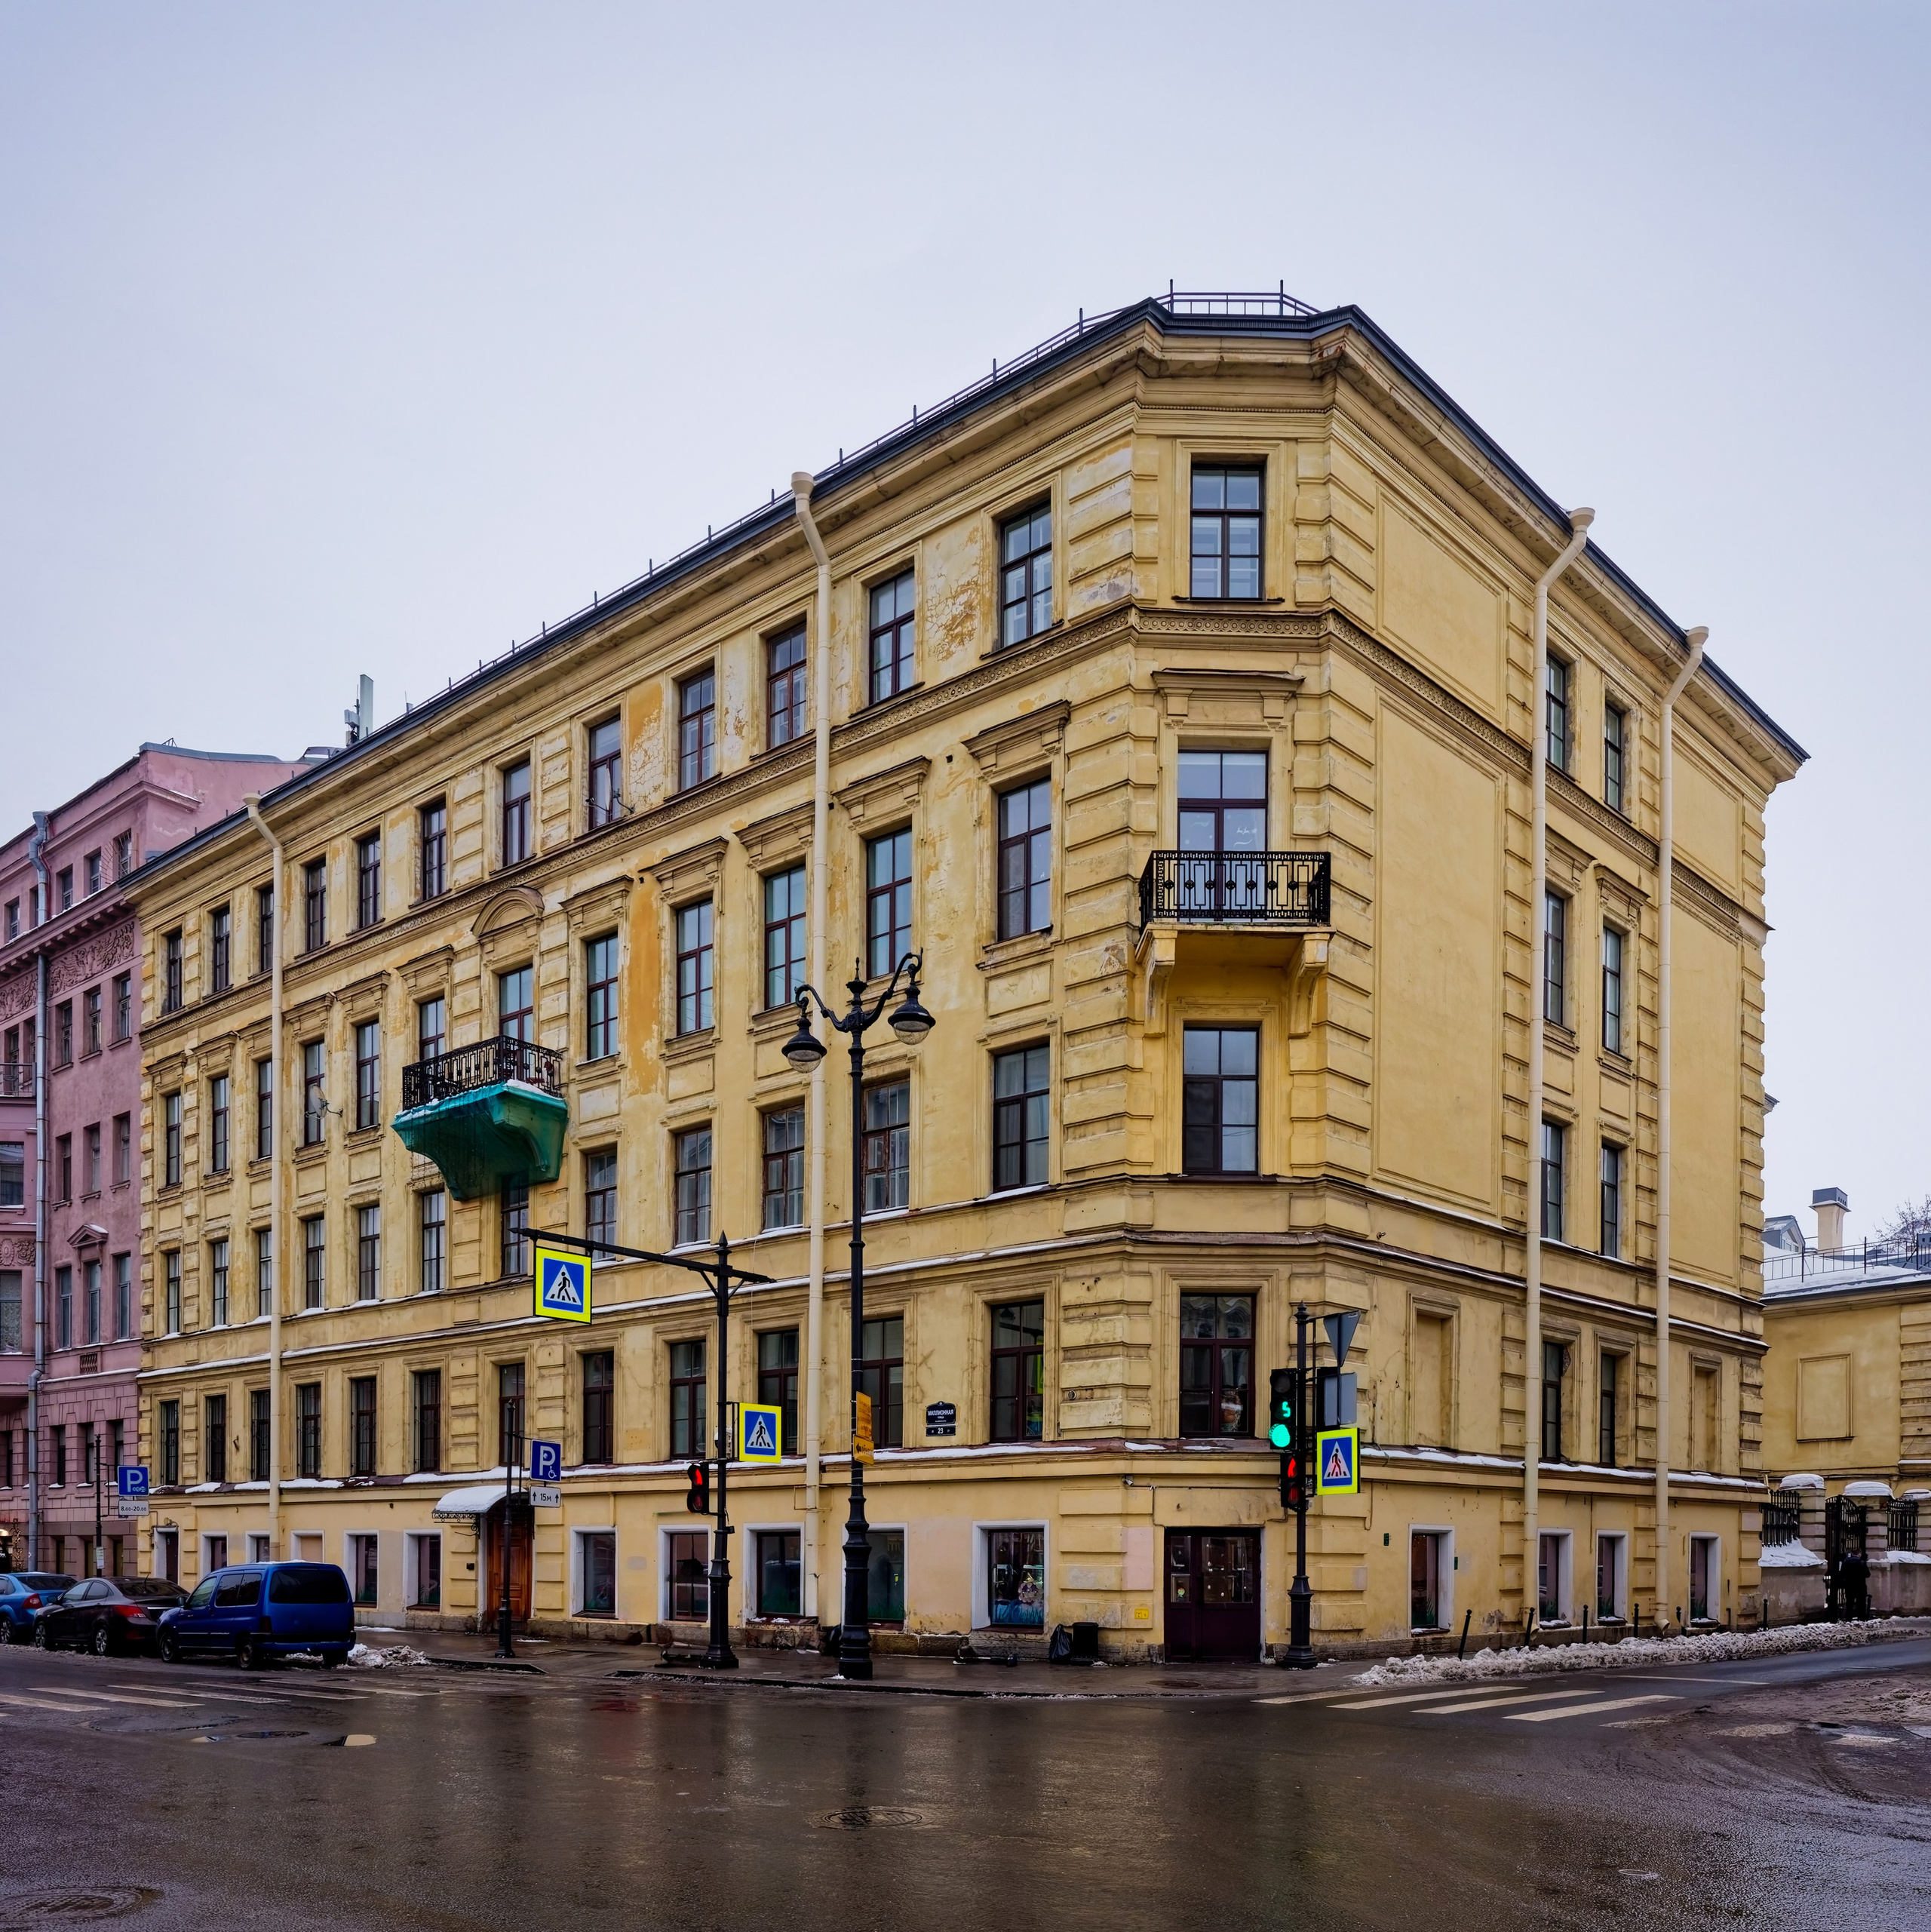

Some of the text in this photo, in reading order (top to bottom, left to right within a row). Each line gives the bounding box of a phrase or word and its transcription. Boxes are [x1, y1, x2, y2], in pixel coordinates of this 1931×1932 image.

[1282, 1401, 1291, 1418] 5
[539, 1445, 556, 1476] P
[127, 1470, 143, 1493] P
